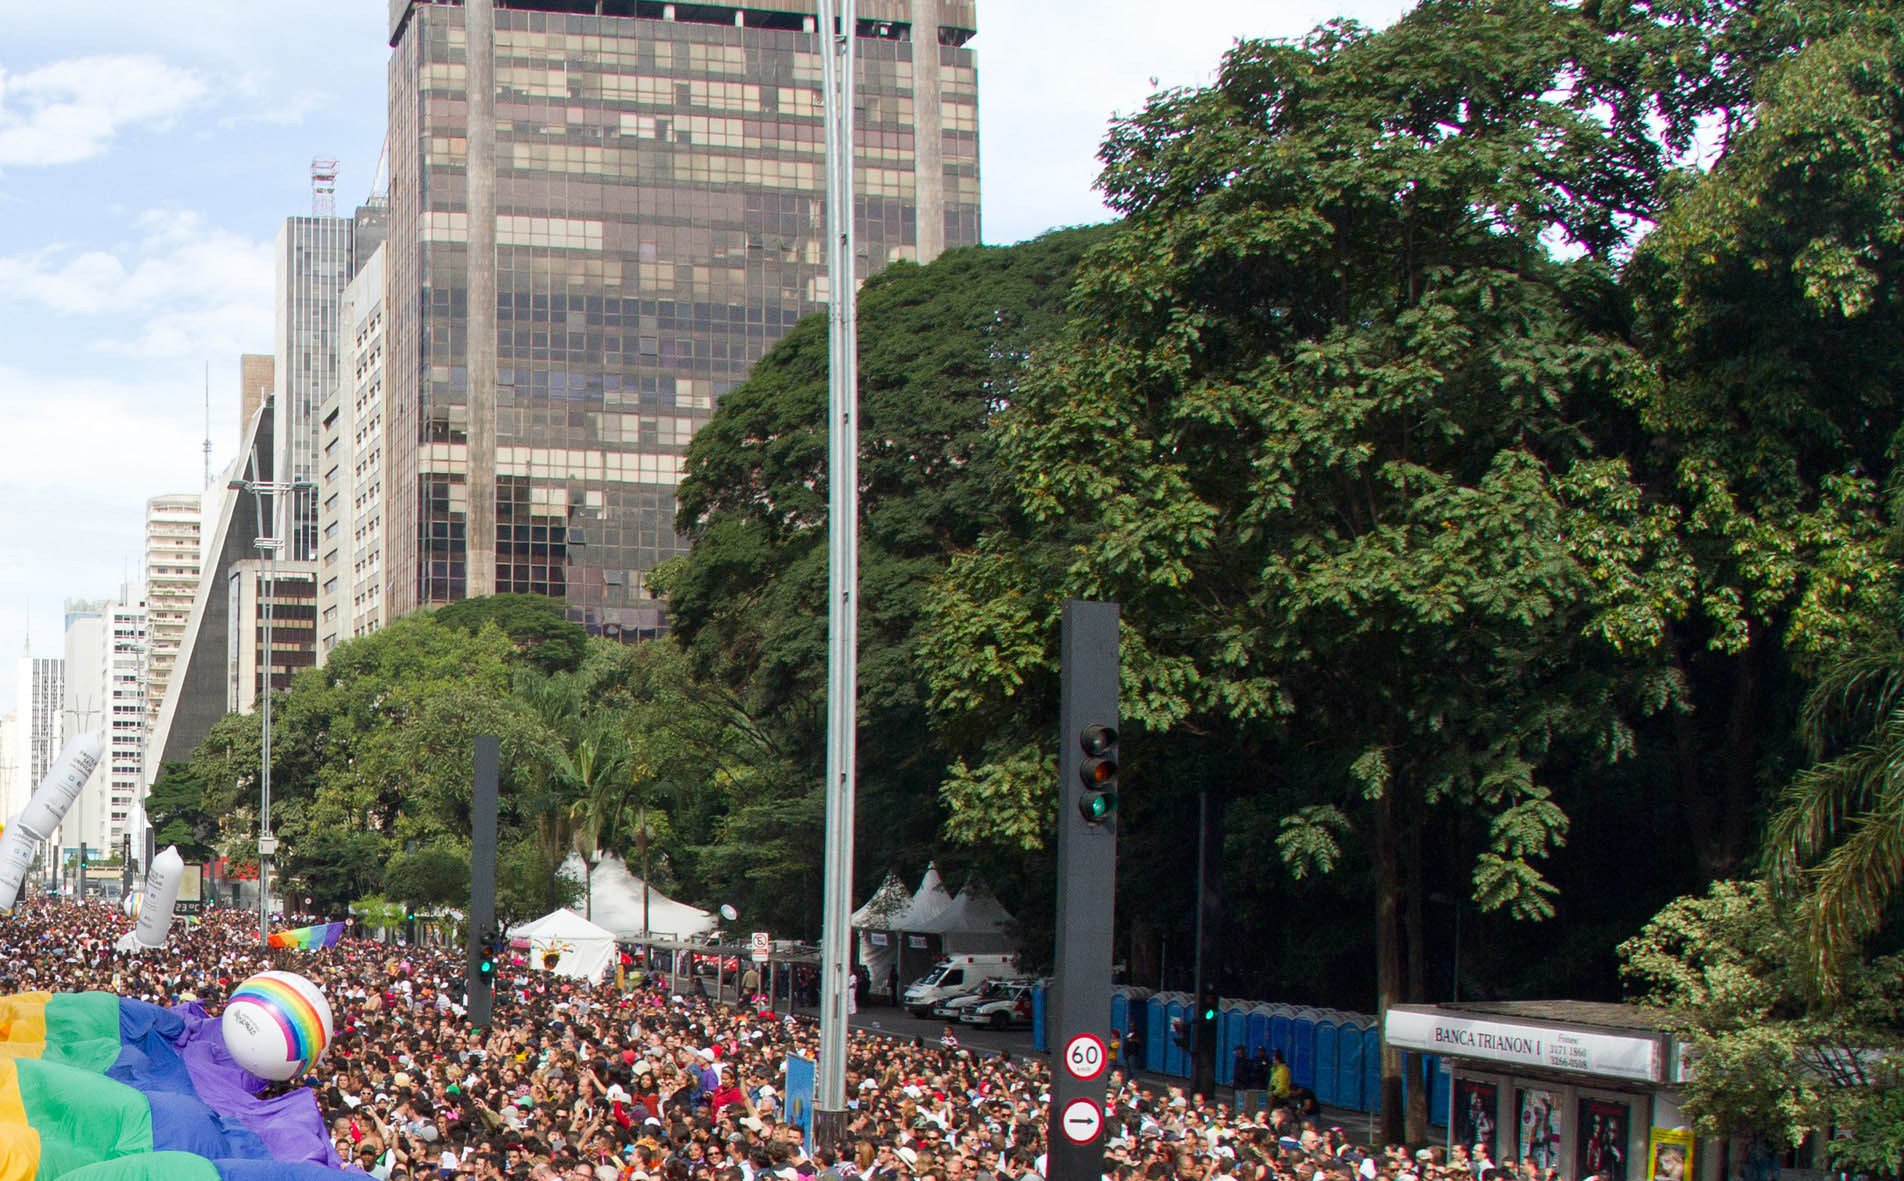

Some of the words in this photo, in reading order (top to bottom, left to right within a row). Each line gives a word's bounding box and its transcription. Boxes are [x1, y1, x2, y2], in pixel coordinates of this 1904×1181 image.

[1435, 1027, 1475, 1047] BANCA
[1477, 1033, 1532, 1055] TRIANON
[1072, 1046, 1098, 1064] 60
